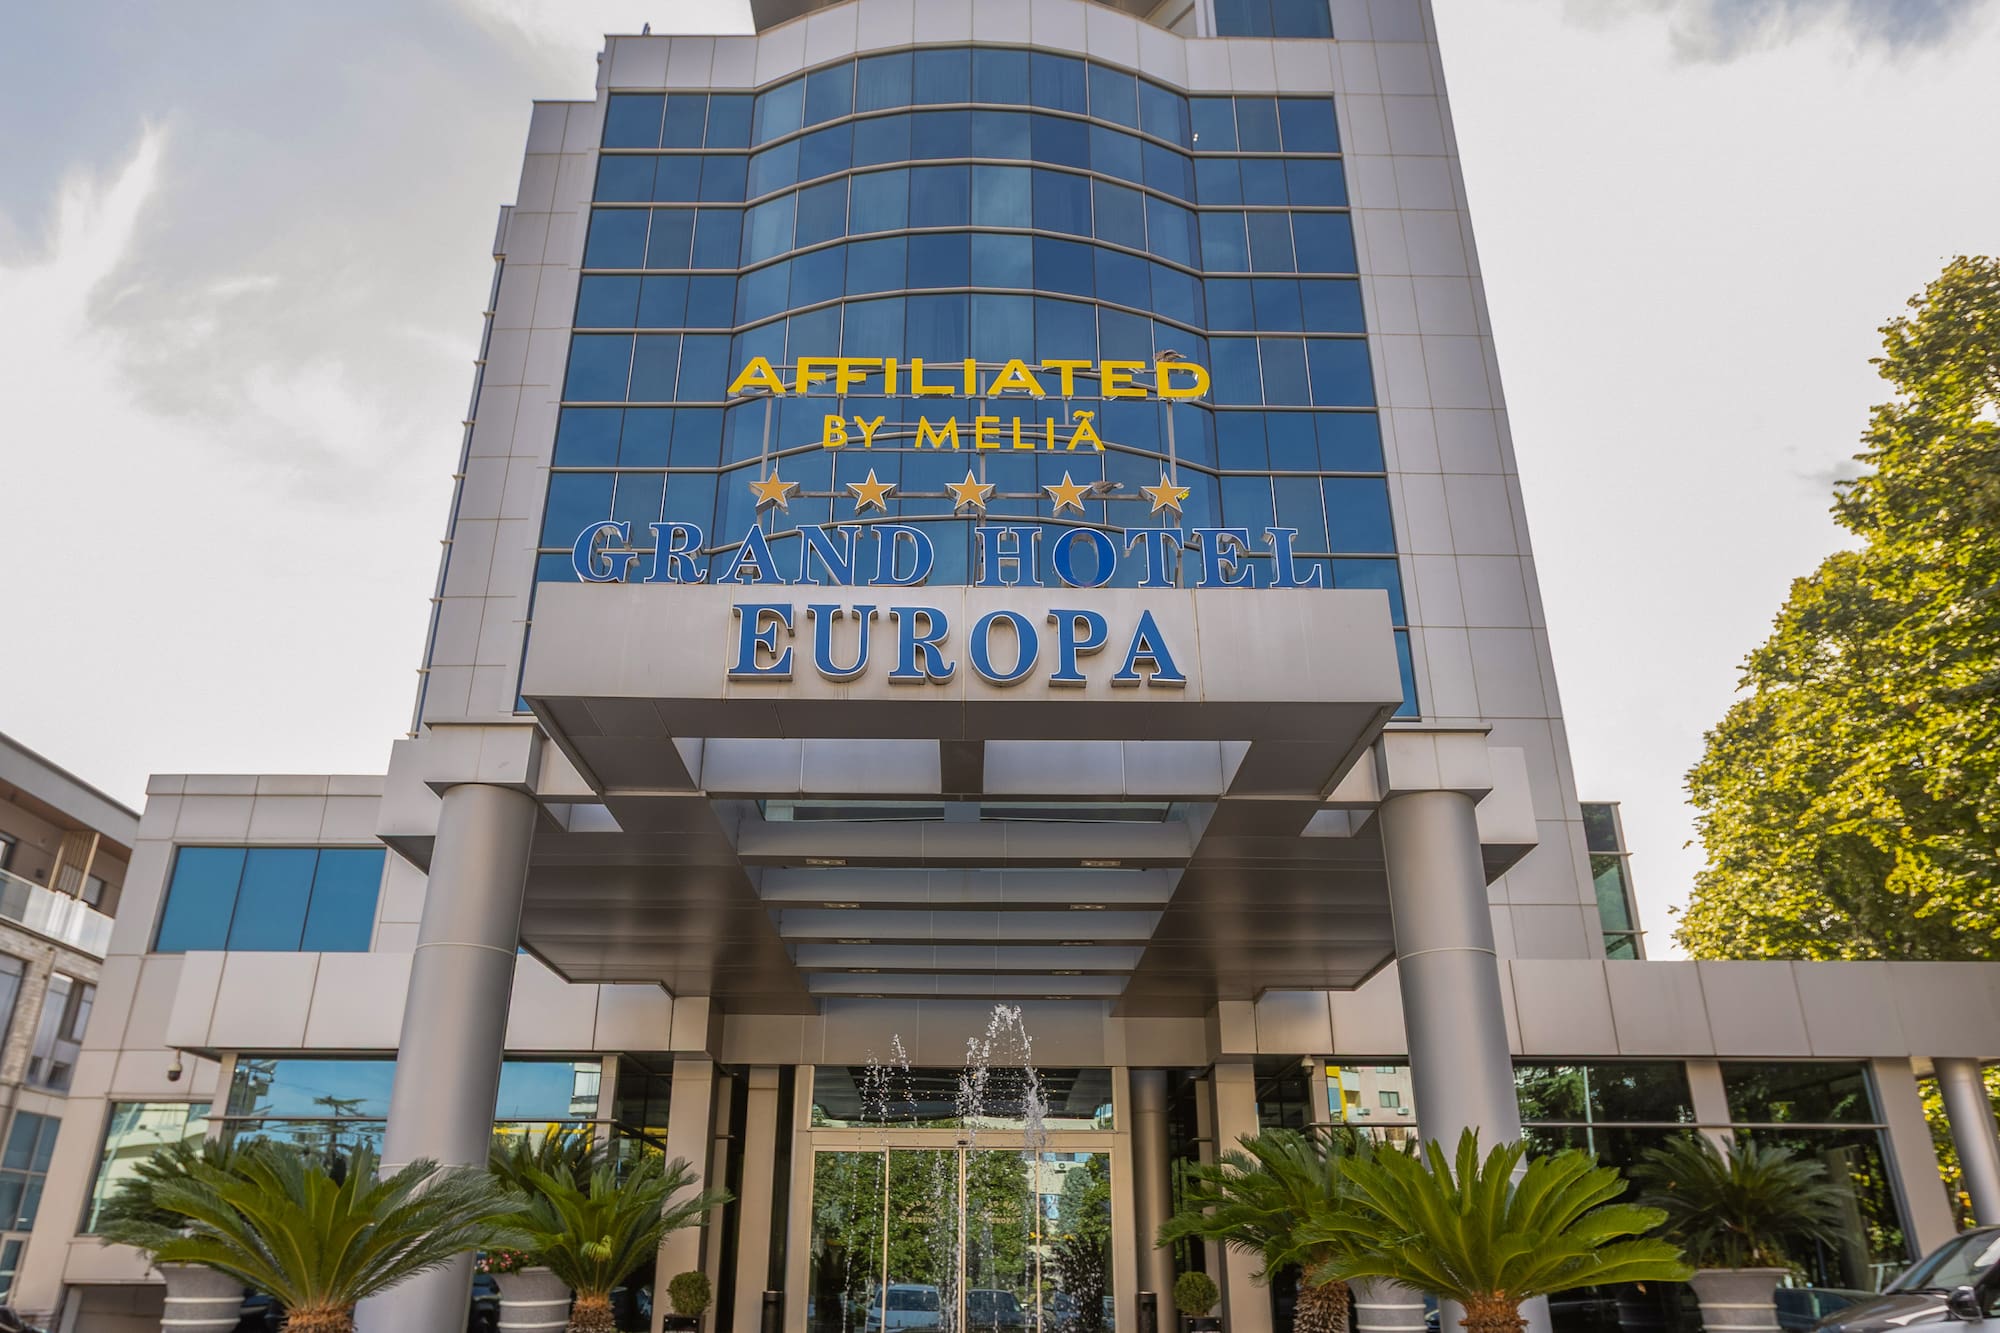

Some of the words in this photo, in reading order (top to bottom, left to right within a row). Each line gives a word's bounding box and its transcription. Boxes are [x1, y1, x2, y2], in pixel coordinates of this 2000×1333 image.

[727, 355, 1211, 400] AFFILIATED
[822, 413, 886, 449] BY
[914, 409, 1106, 451] MELIÃ
[572, 520, 935, 587] GRAND
[974, 527, 1323, 589] HOTEL
[727, 603, 1187, 687] EUROPA
